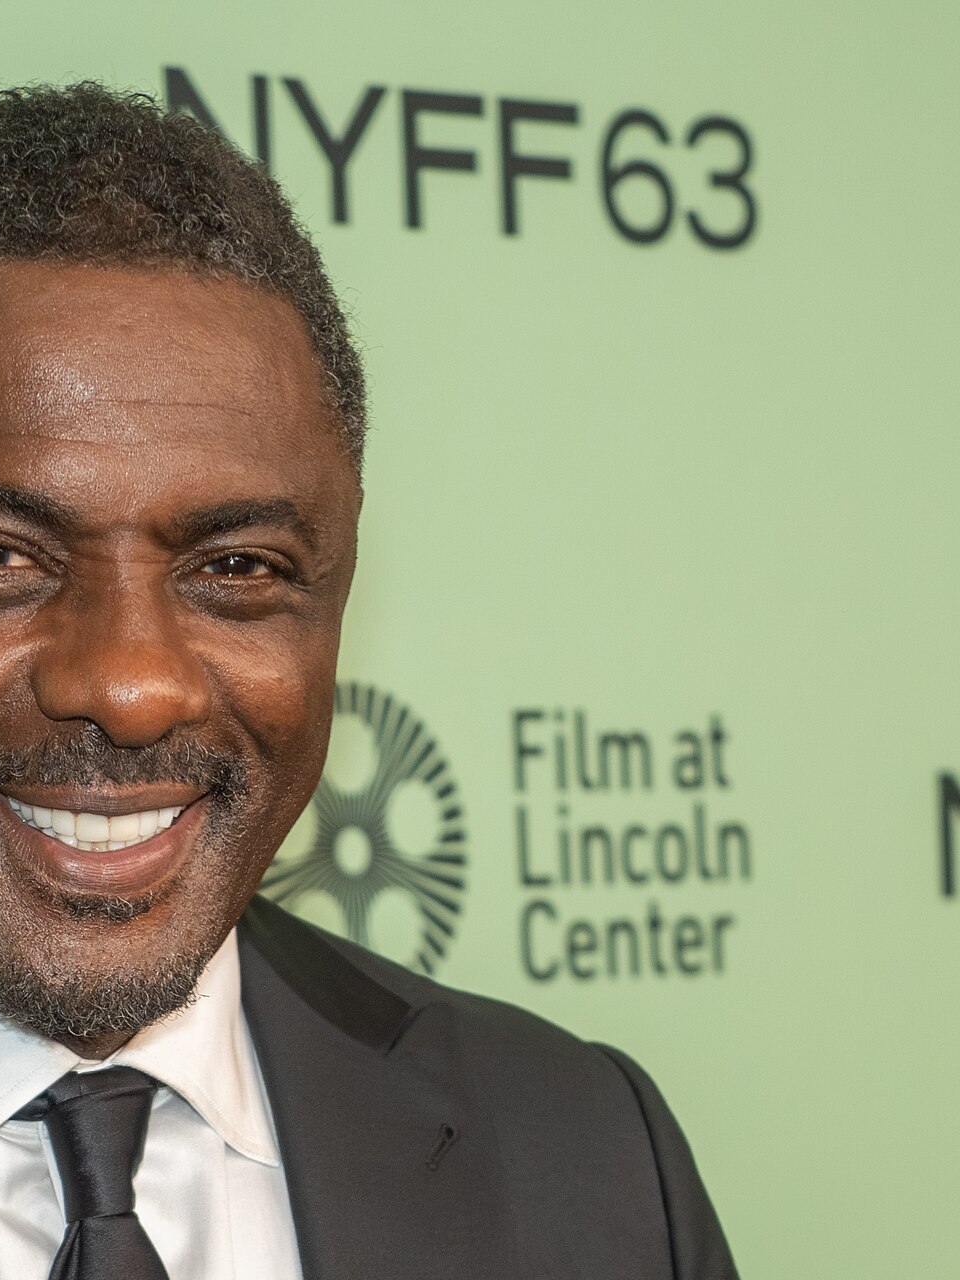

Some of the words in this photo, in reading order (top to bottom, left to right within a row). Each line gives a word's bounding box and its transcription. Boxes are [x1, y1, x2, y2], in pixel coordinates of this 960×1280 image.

[513, 708, 654, 792] Film
[672, 712, 731, 791] at
[516, 800, 753, 888] Lincoln
[519, 899, 736, 984] Center
